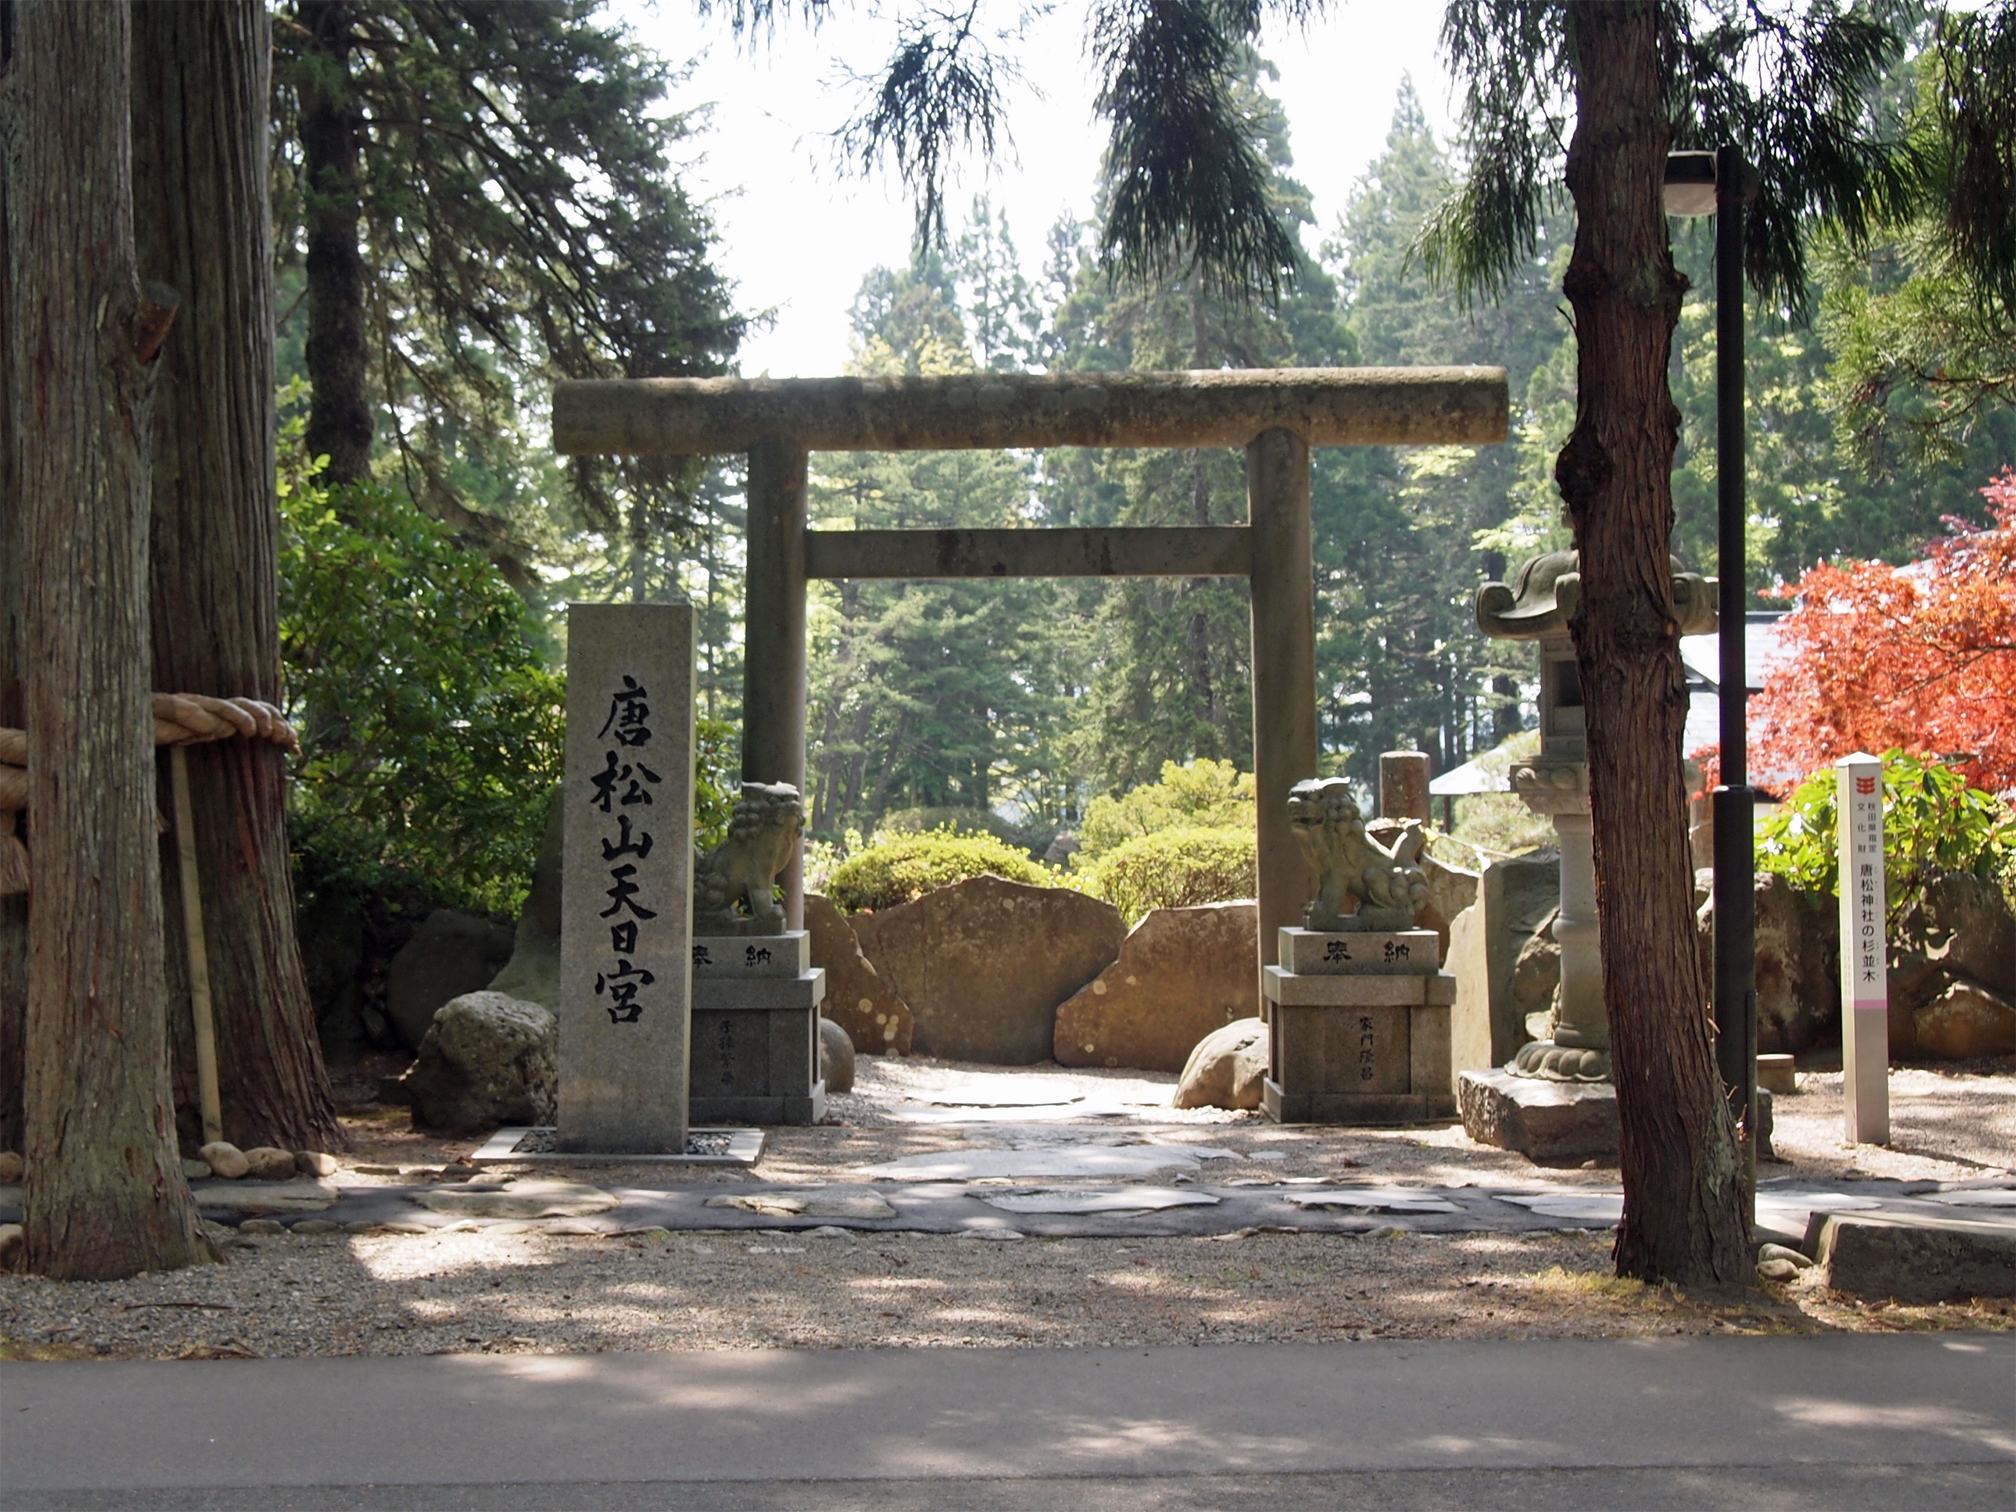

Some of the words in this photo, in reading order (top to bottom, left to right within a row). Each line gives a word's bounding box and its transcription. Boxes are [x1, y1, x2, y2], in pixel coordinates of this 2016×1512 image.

[591, 675, 662, 1024] 唐松山天日宮
[1857, 803, 1866, 853] 文化財
[1868, 802, 1877, 853] 秋田県指定
[1861, 863, 1876, 983] 唐松神社の杉並木
